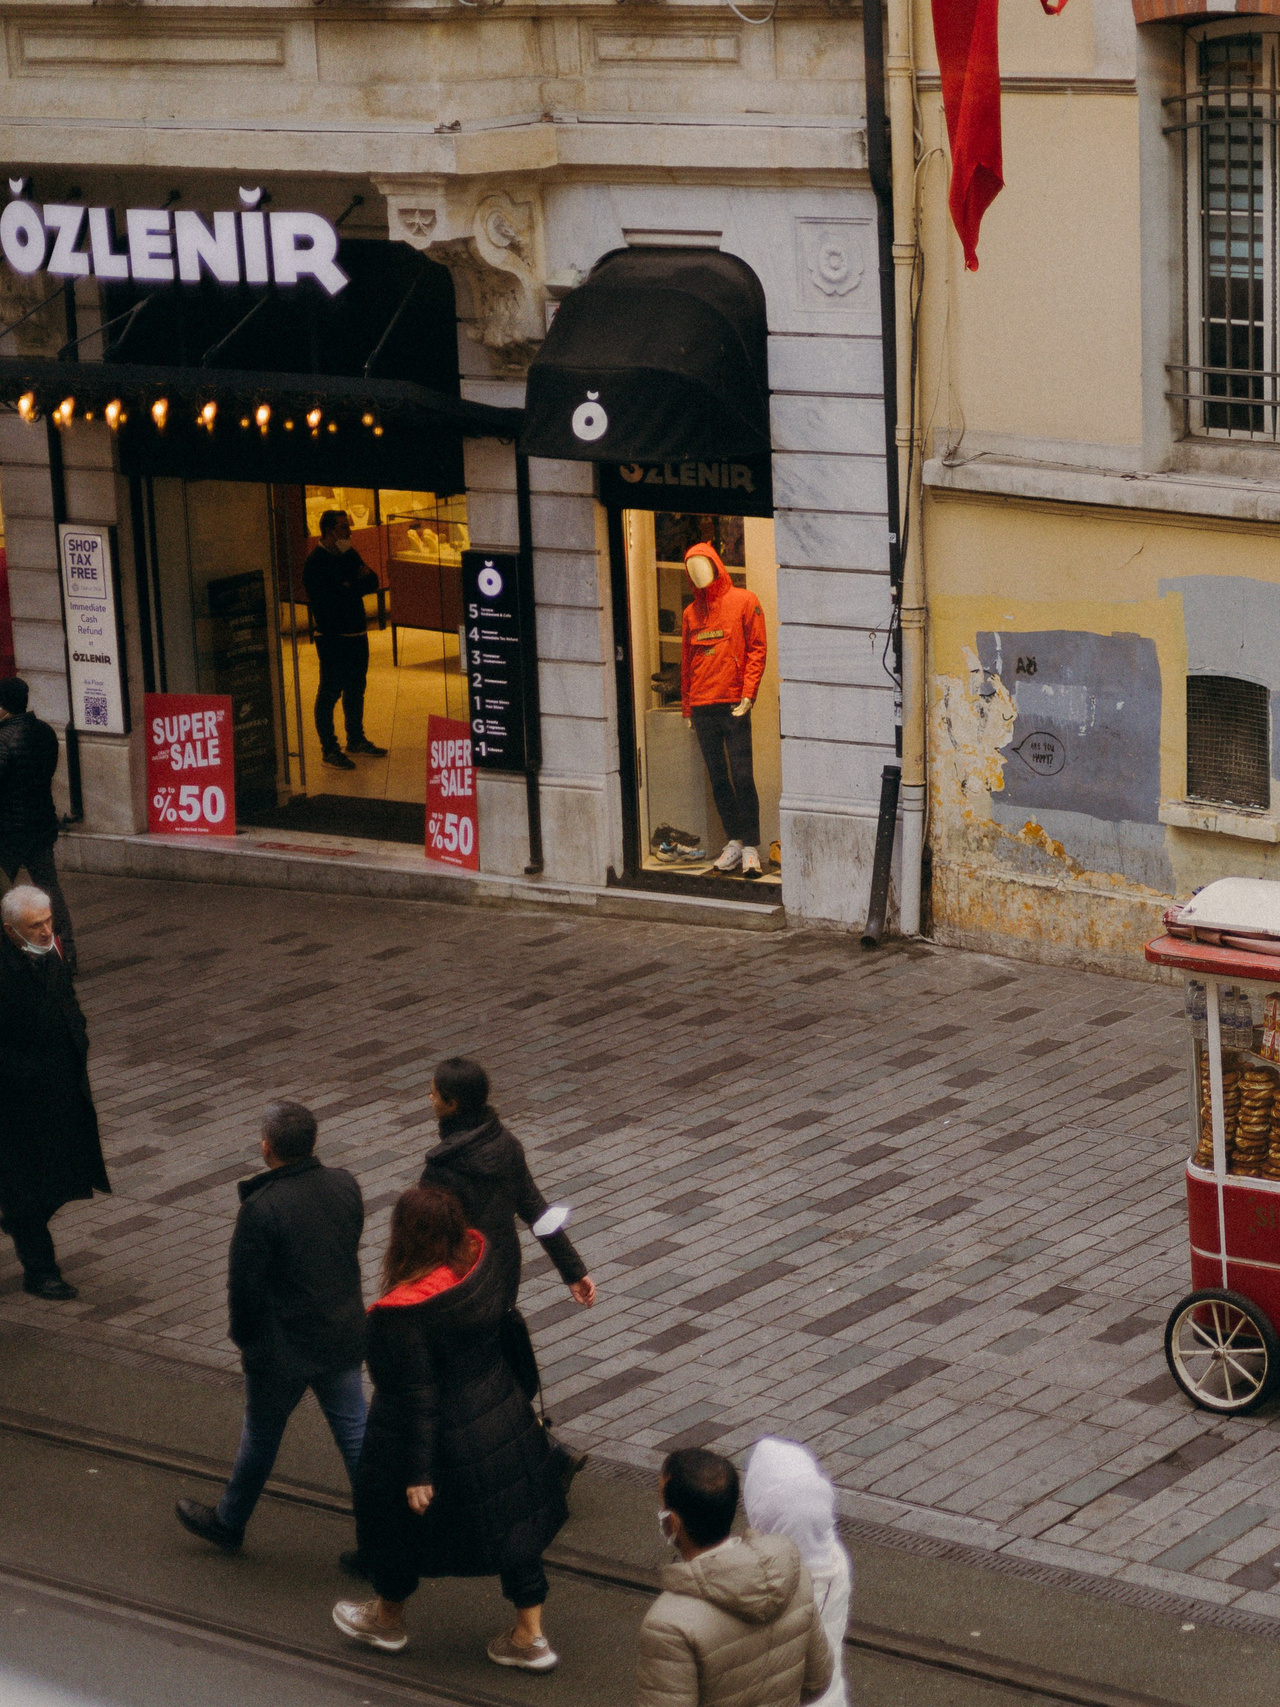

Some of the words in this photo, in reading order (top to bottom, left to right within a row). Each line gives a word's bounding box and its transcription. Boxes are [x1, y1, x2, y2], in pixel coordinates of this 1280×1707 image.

[68, 538, 98, 552] SHOP
[69, 553, 92, 566] TAX
[70, 567, 98, 580] FREE
[70, 602, 107, 612] Immediate
[469, 603, 479, 618] 5
[81, 614, 98, 623] Cash
[77, 625, 102, 635] Refund
[469, 626, 480, 641] 4
[471, 650, 481, 665] 3
[472, 672, 482, 688] 2
[474, 695, 481, 710] 1
[152, 710, 219, 745] SUPER
[472, 718, 485, 734] G
[170, 738, 221, 770] SALE
[430, 738, 472, 769] SUPER
[167, 786, 176, 794] to
[440, 768, 473, 797] SALE
[153, 785, 225, 823] %50
[428, 812, 474, 856] %50
